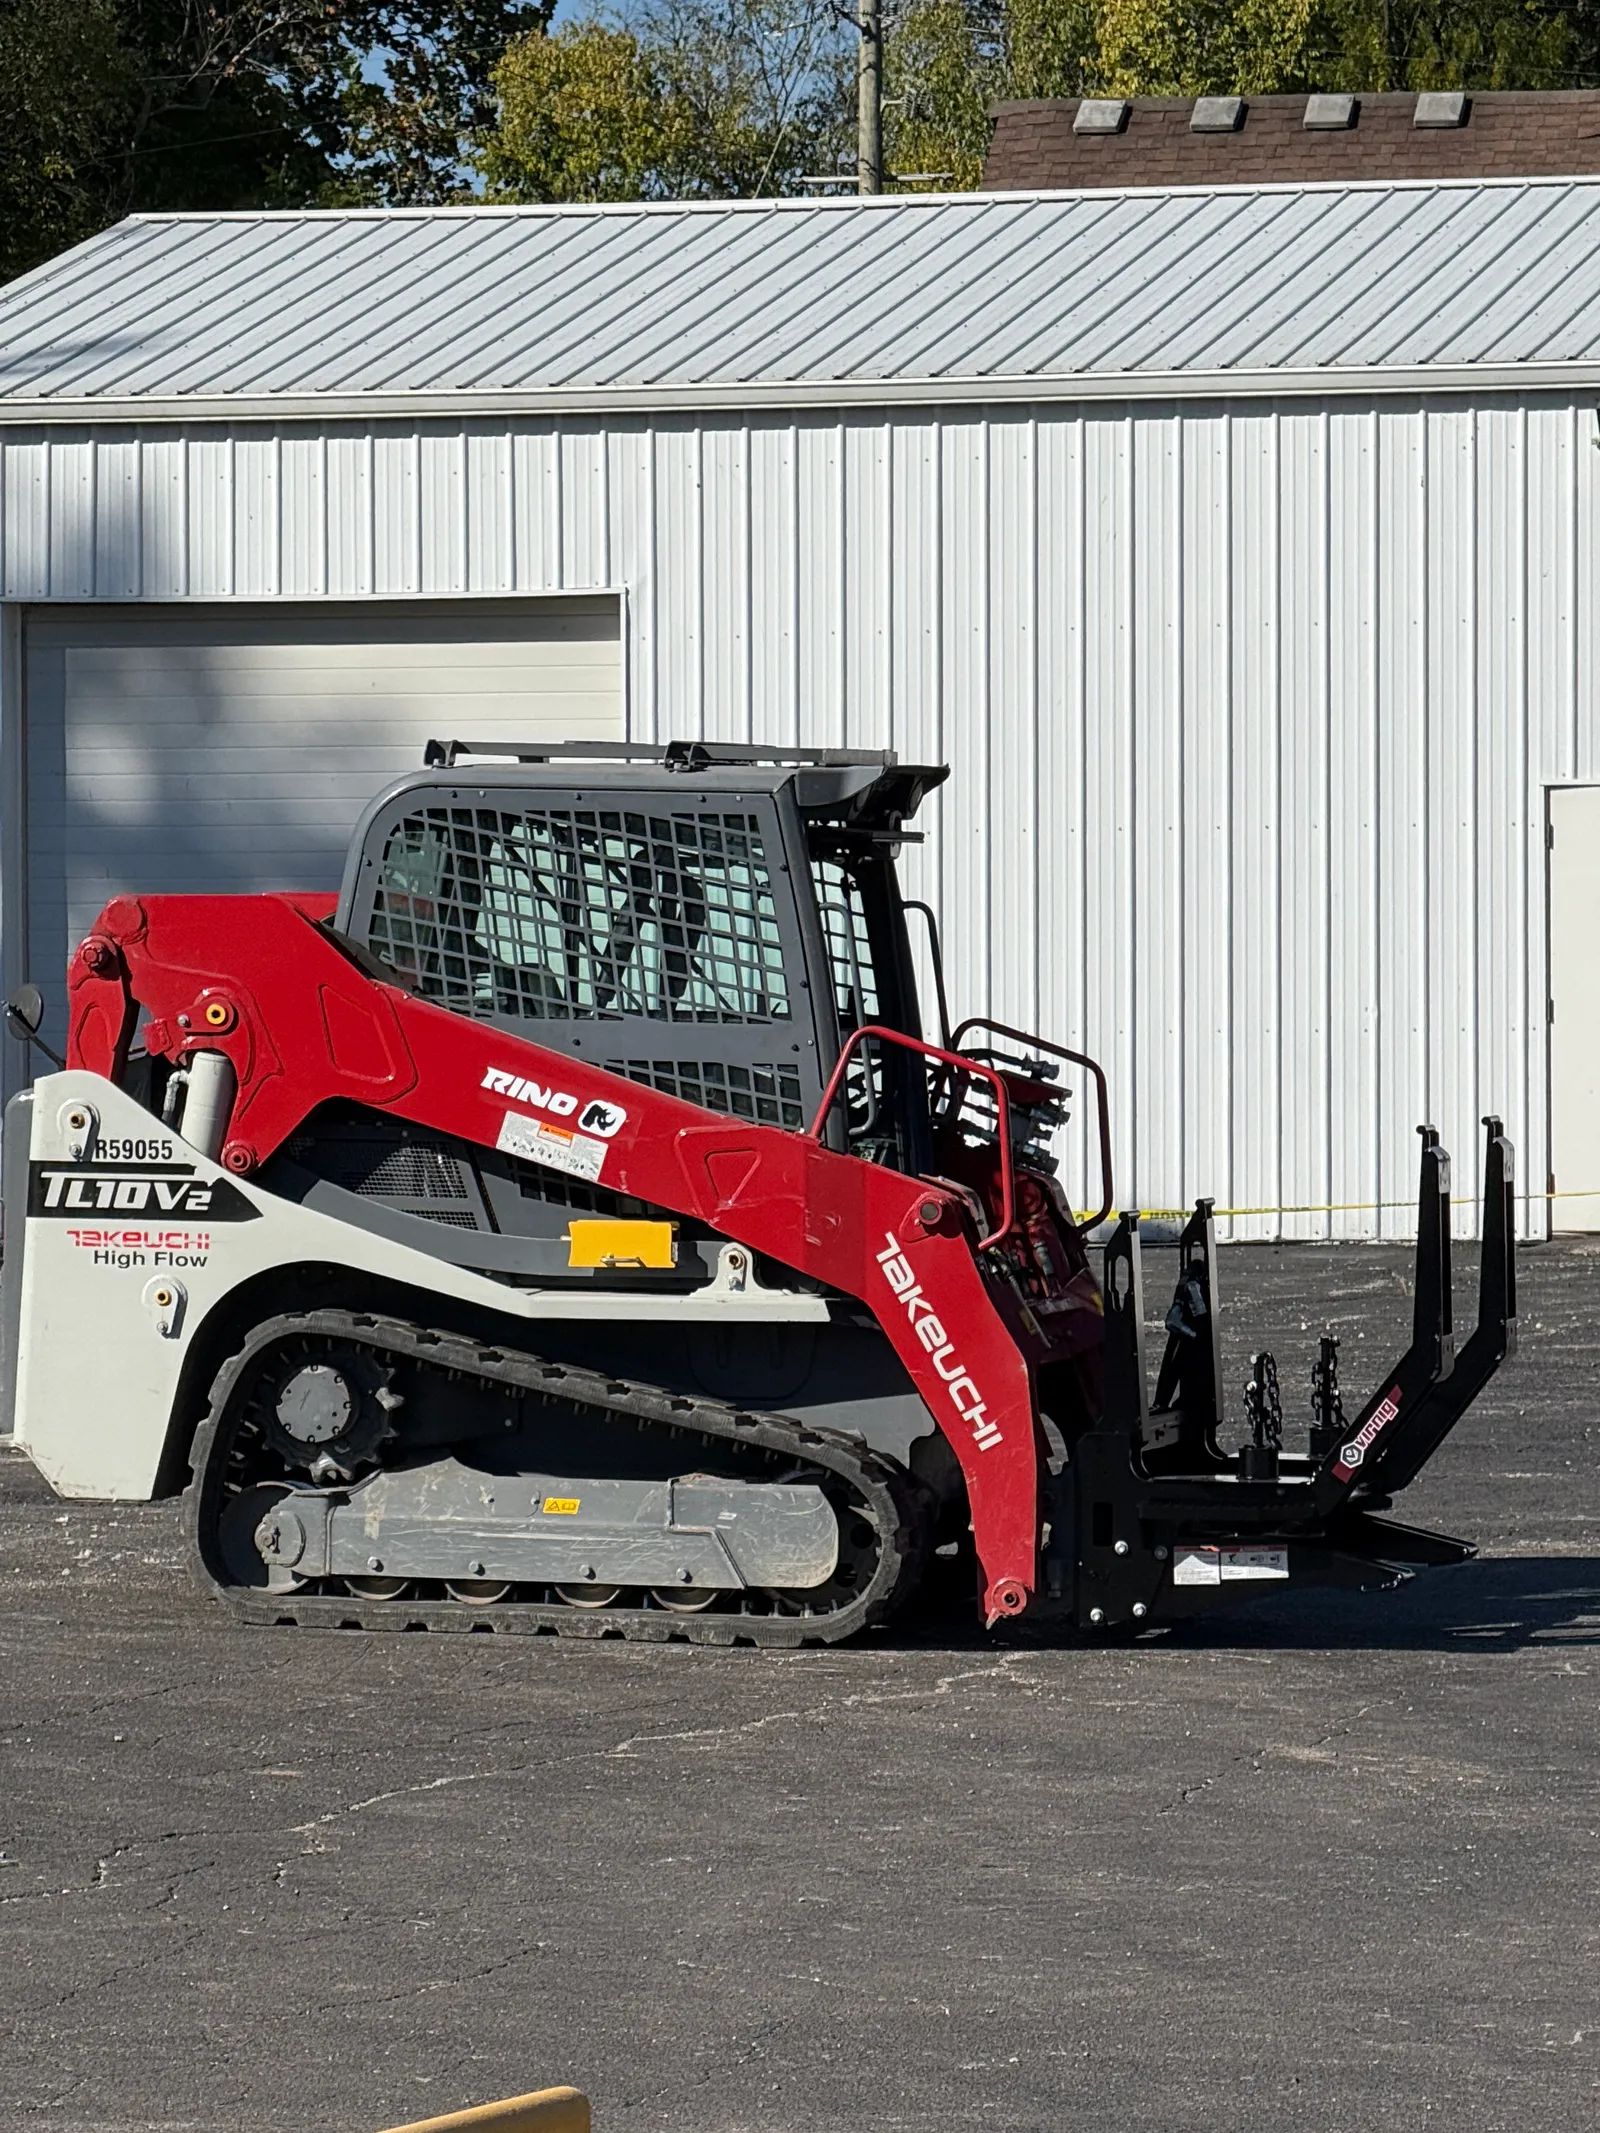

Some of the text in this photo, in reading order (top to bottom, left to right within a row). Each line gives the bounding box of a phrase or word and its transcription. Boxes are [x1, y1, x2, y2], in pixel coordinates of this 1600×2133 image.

[480, 1066, 578, 1116] RINO
[95, 1139, 173, 1160] R59055
[93, 1250, 208, 1269] High Flow
